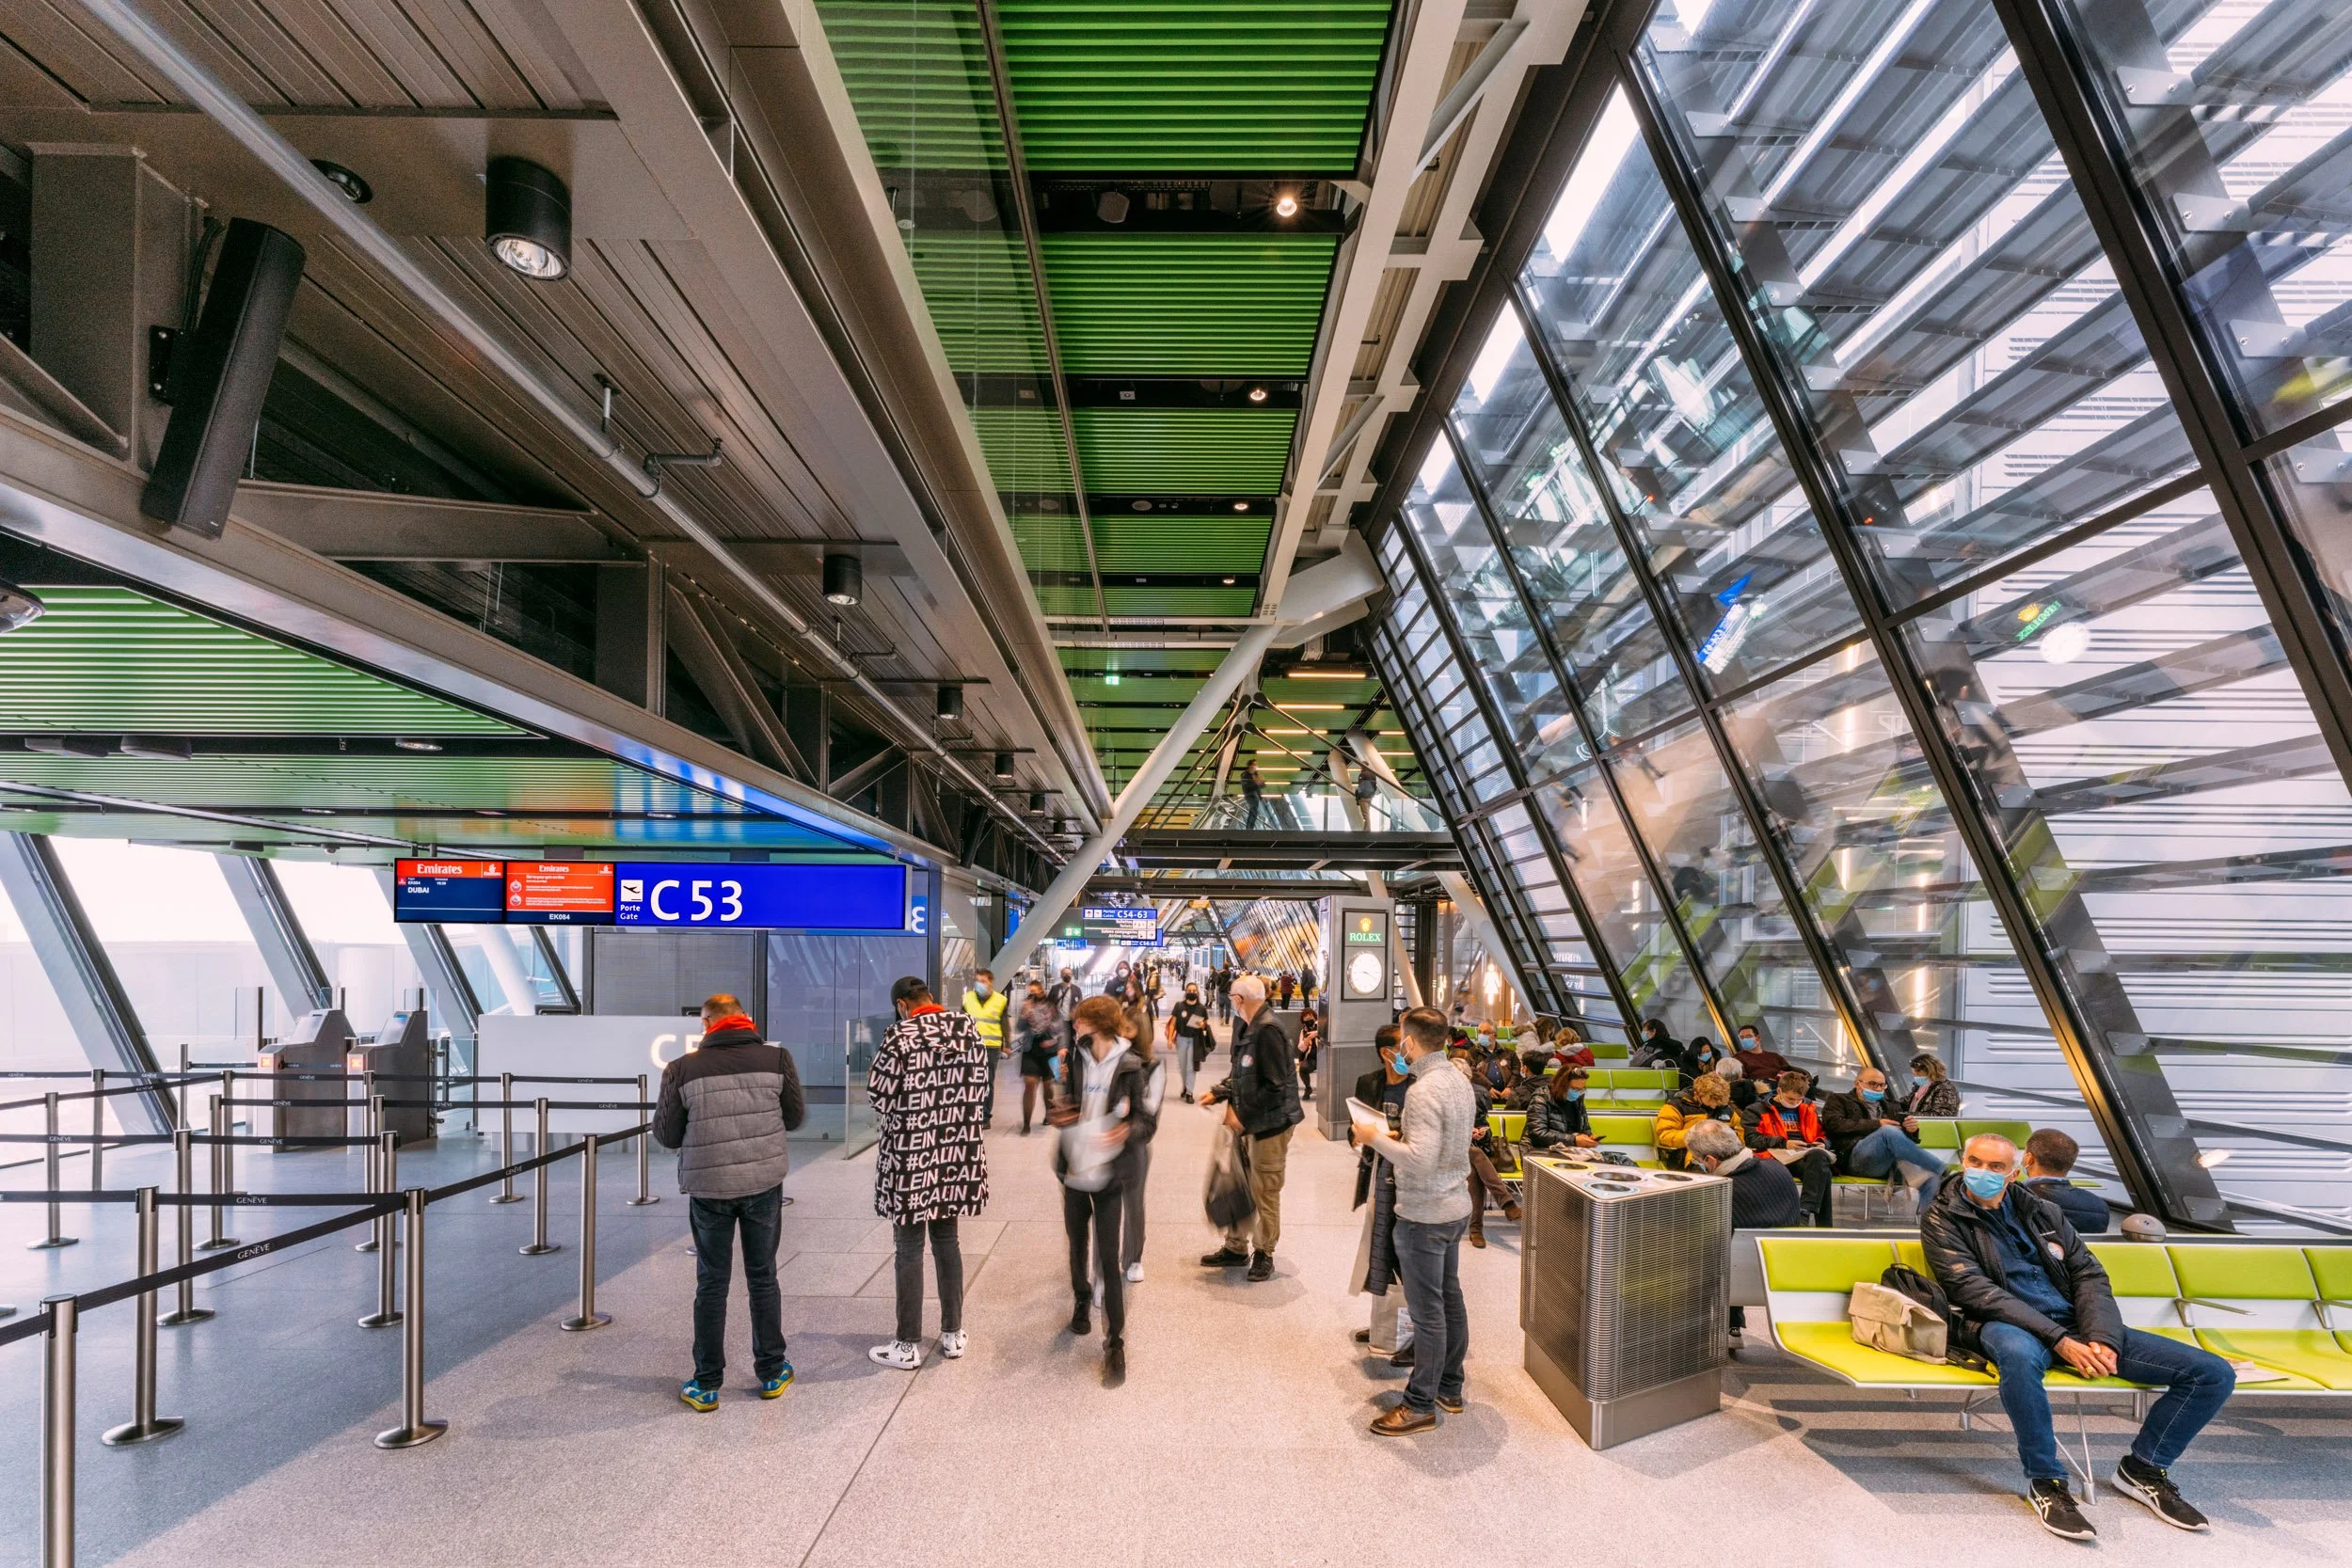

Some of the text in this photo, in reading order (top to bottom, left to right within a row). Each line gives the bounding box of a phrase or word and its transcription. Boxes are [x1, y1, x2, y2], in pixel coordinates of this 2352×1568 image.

[417, 863, 463, 874] Emirates
[1117, 911, 1148, 919] C54-63
[1349, 932, 1381, 942] ROLEX
[236, 1194, 267, 1204] GENÈVE
[237, 1243, 271, 1260] GENÈVE
